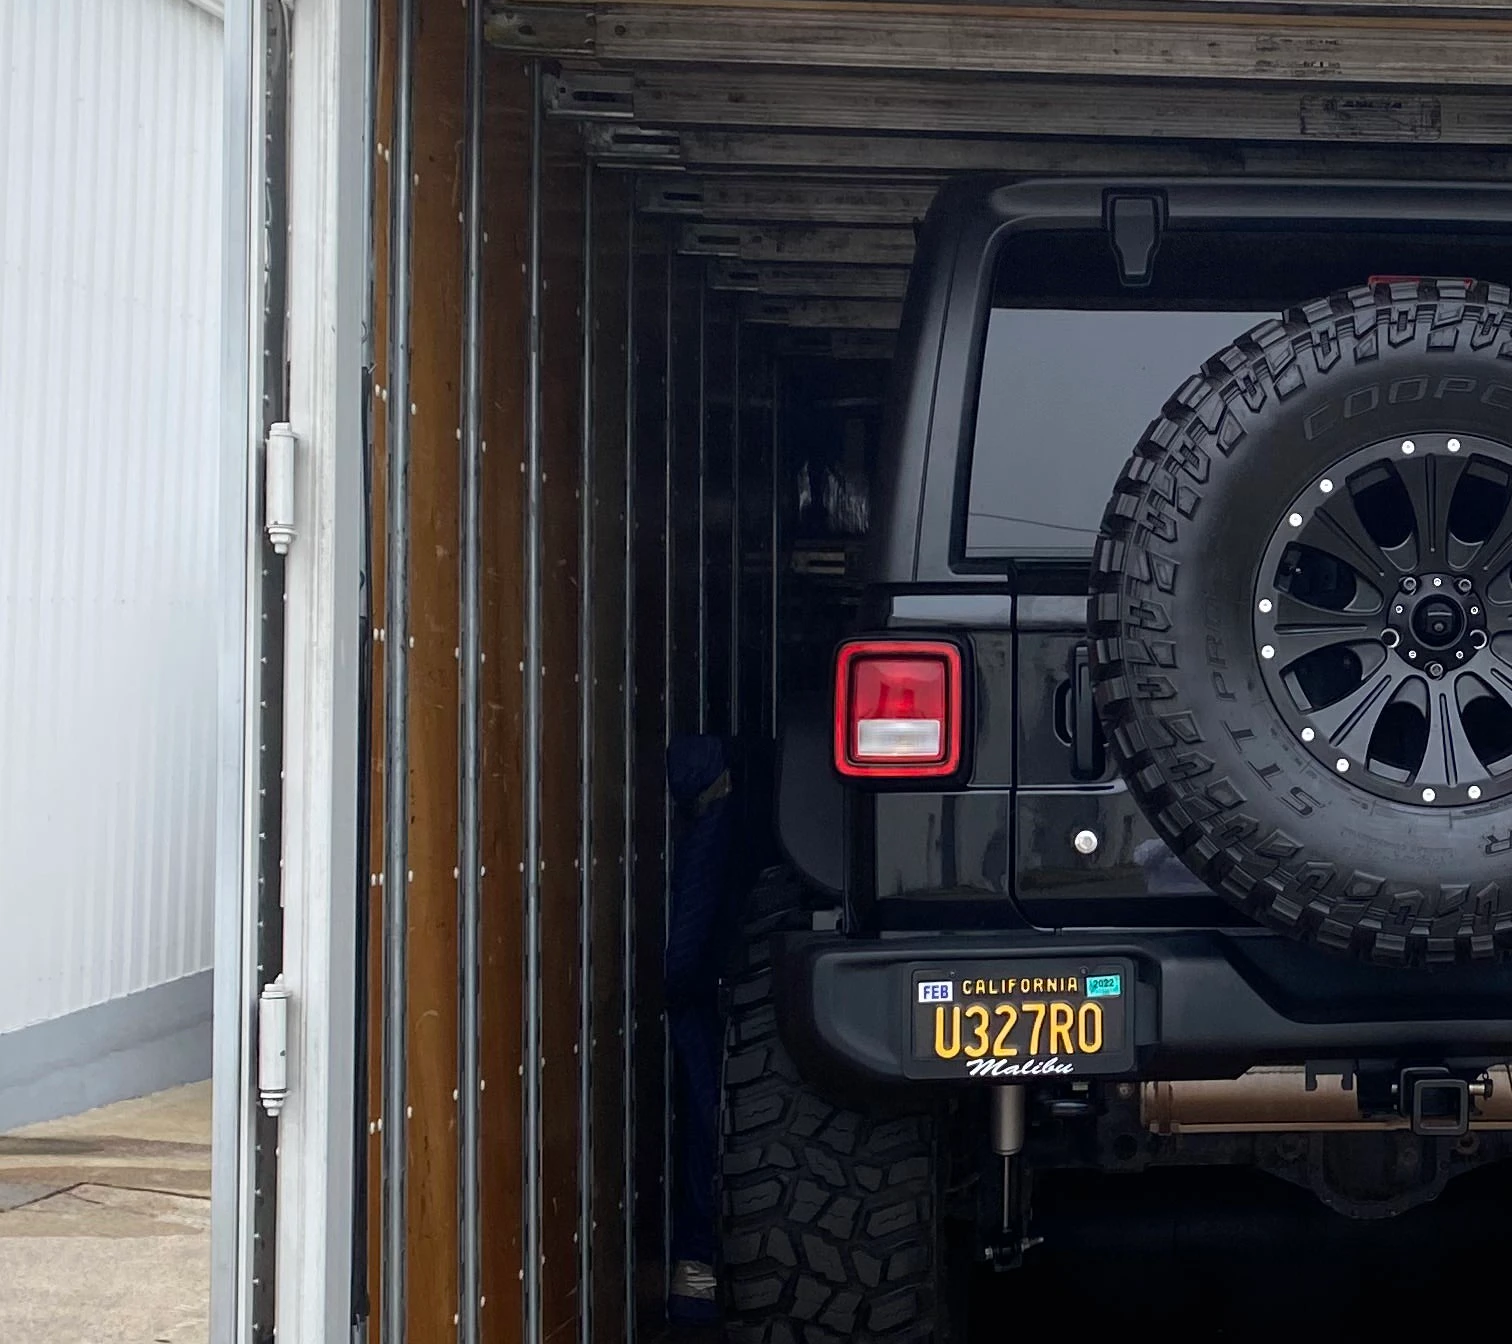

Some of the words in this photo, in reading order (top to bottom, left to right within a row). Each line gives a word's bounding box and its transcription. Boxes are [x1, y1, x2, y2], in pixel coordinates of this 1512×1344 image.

[962, 977, 1079, 995] CALIFORNIA
[1093, 978, 1115, 988] 2022
[923, 984, 949, 1000] FEB
[966, 1056, 1075, 1077] Malibu
